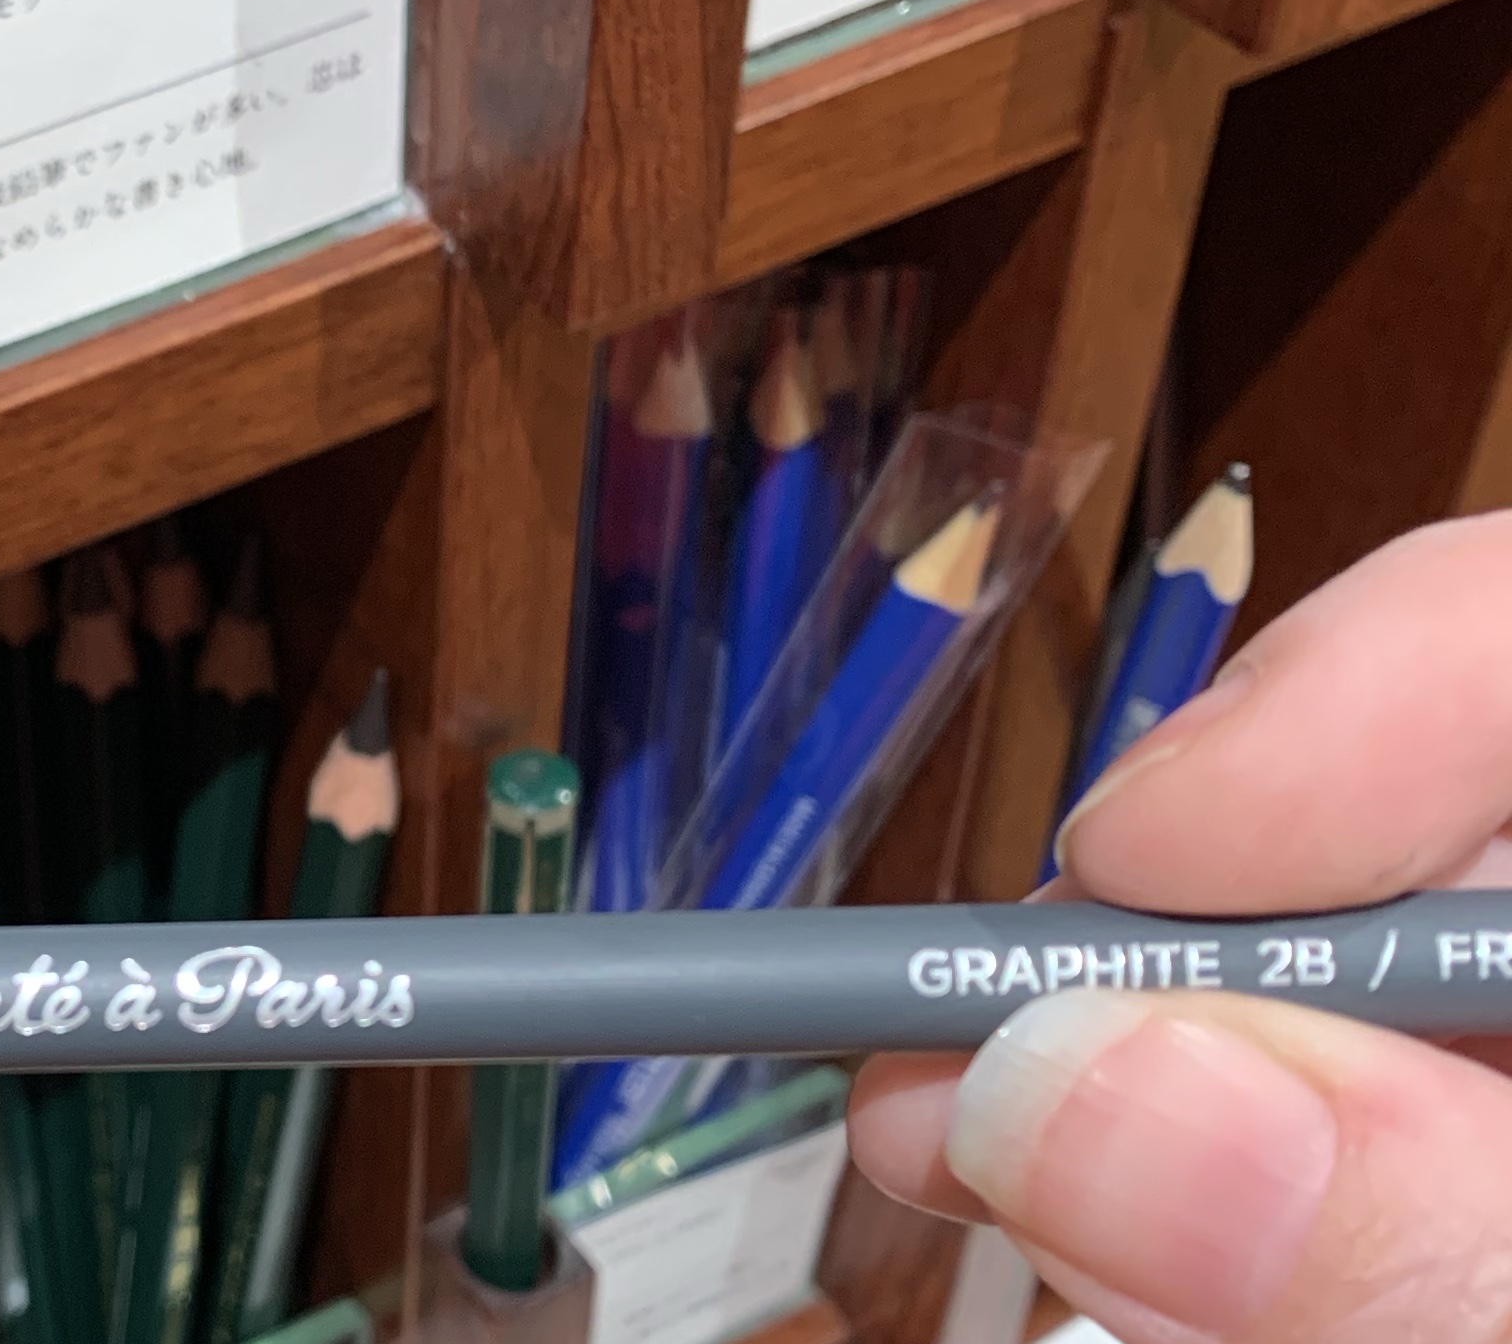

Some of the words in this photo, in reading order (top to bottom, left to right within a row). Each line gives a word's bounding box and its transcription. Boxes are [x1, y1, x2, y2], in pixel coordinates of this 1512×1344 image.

[104, 956, 165, 1033] à
[174, 944, 416, 1035] Paris
[906, 940, 1223, 999] GRAPHITE
[1257, 937, 1337, 988] 2B
